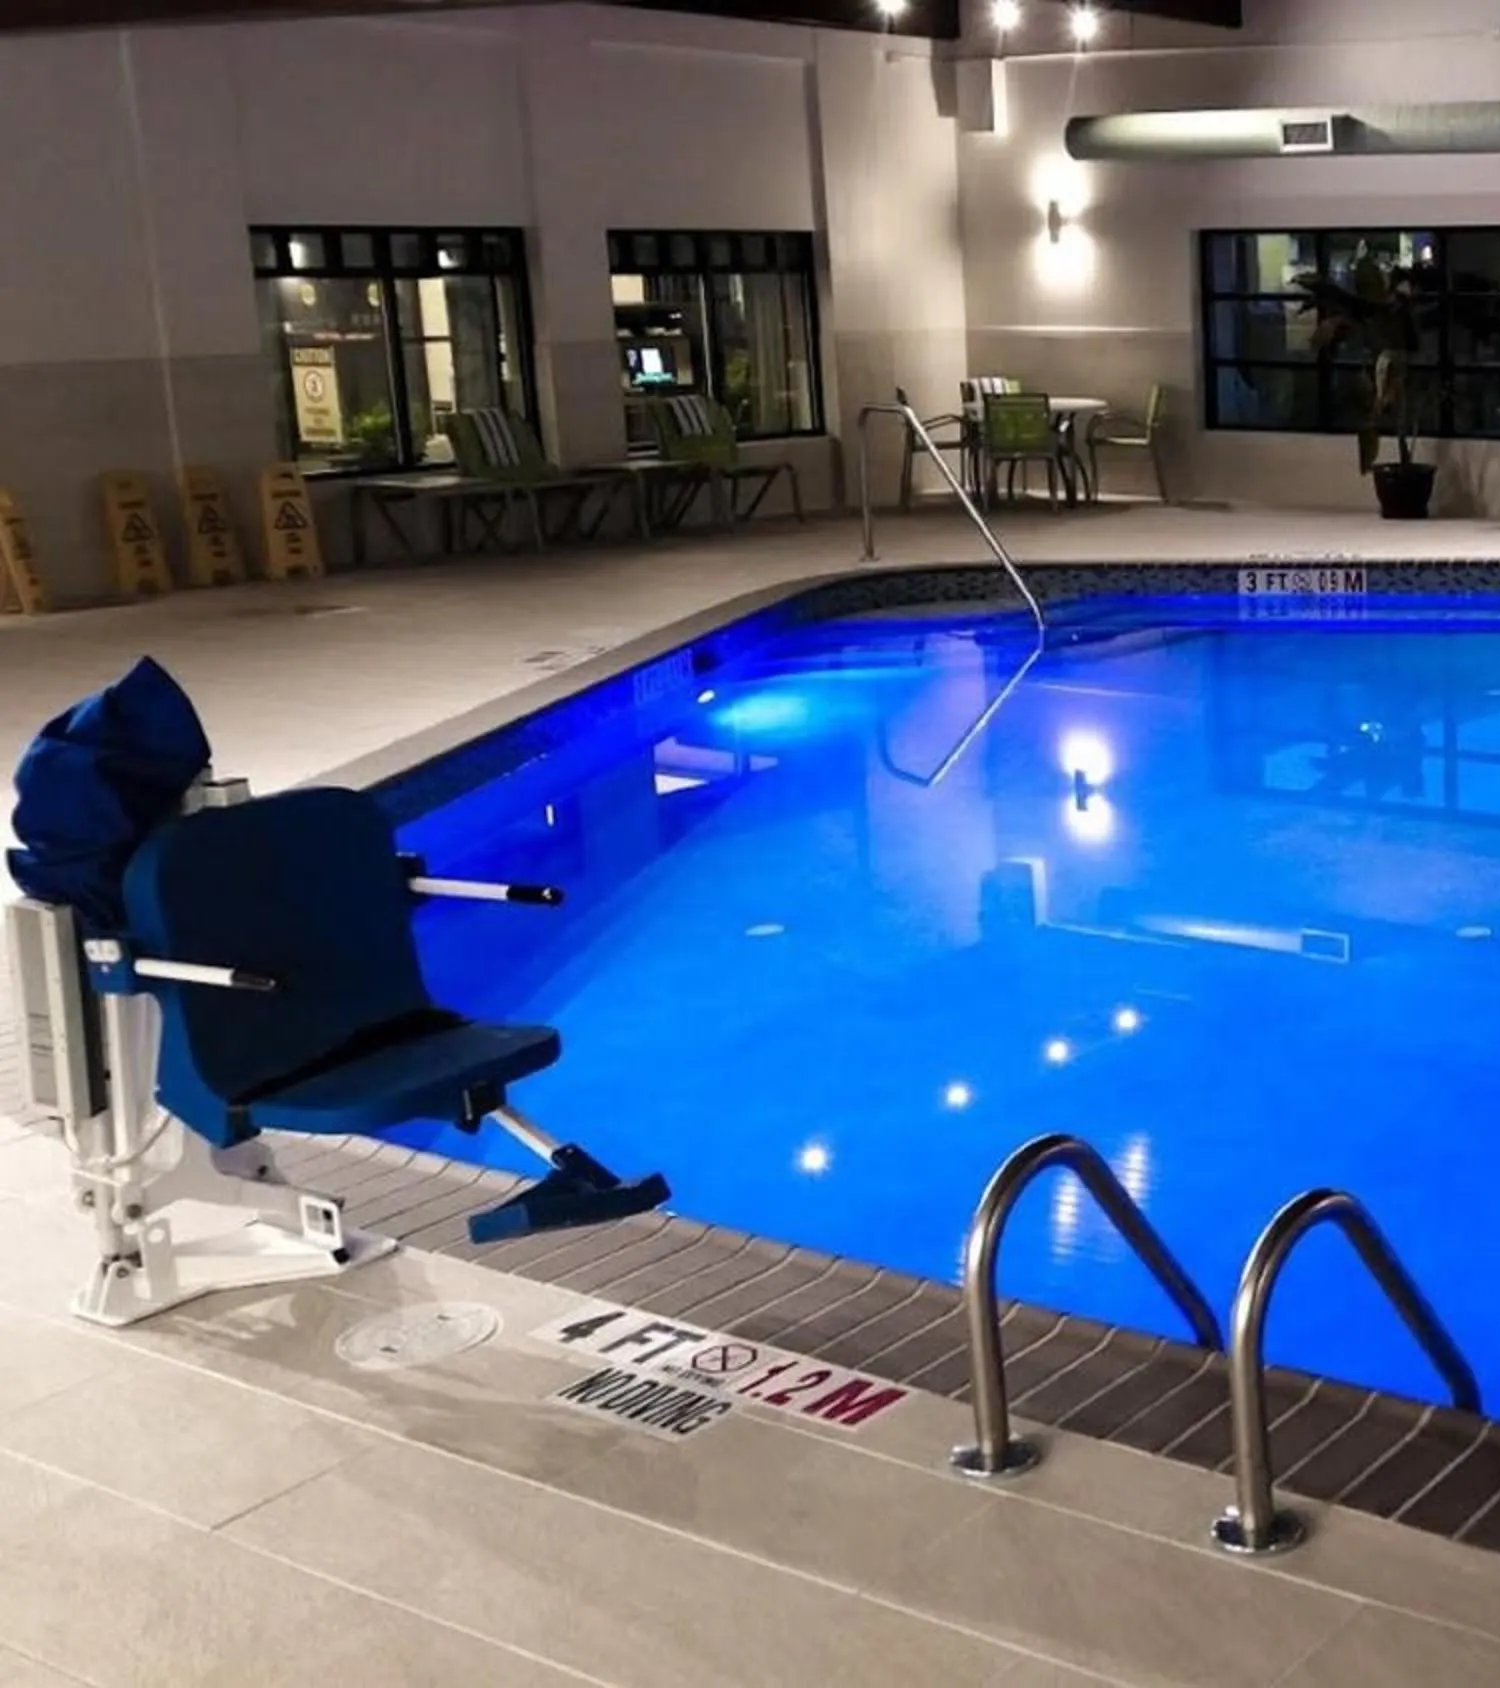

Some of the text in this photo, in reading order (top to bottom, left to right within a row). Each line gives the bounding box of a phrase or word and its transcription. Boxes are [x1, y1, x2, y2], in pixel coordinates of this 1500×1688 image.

[1246, 572, 1257, 592] 3
[1344, 572, 1364, 593] M
[557, 1367, 636, 1405] NO
[559, 1311, 627, 1343] 4
[599, 1322, 706, 1364] FT
[737, 1361, 833, 1406] 1.2
[802, 1379, 908, 1425] M
[596, 1379, 732, 1434] DIVING
